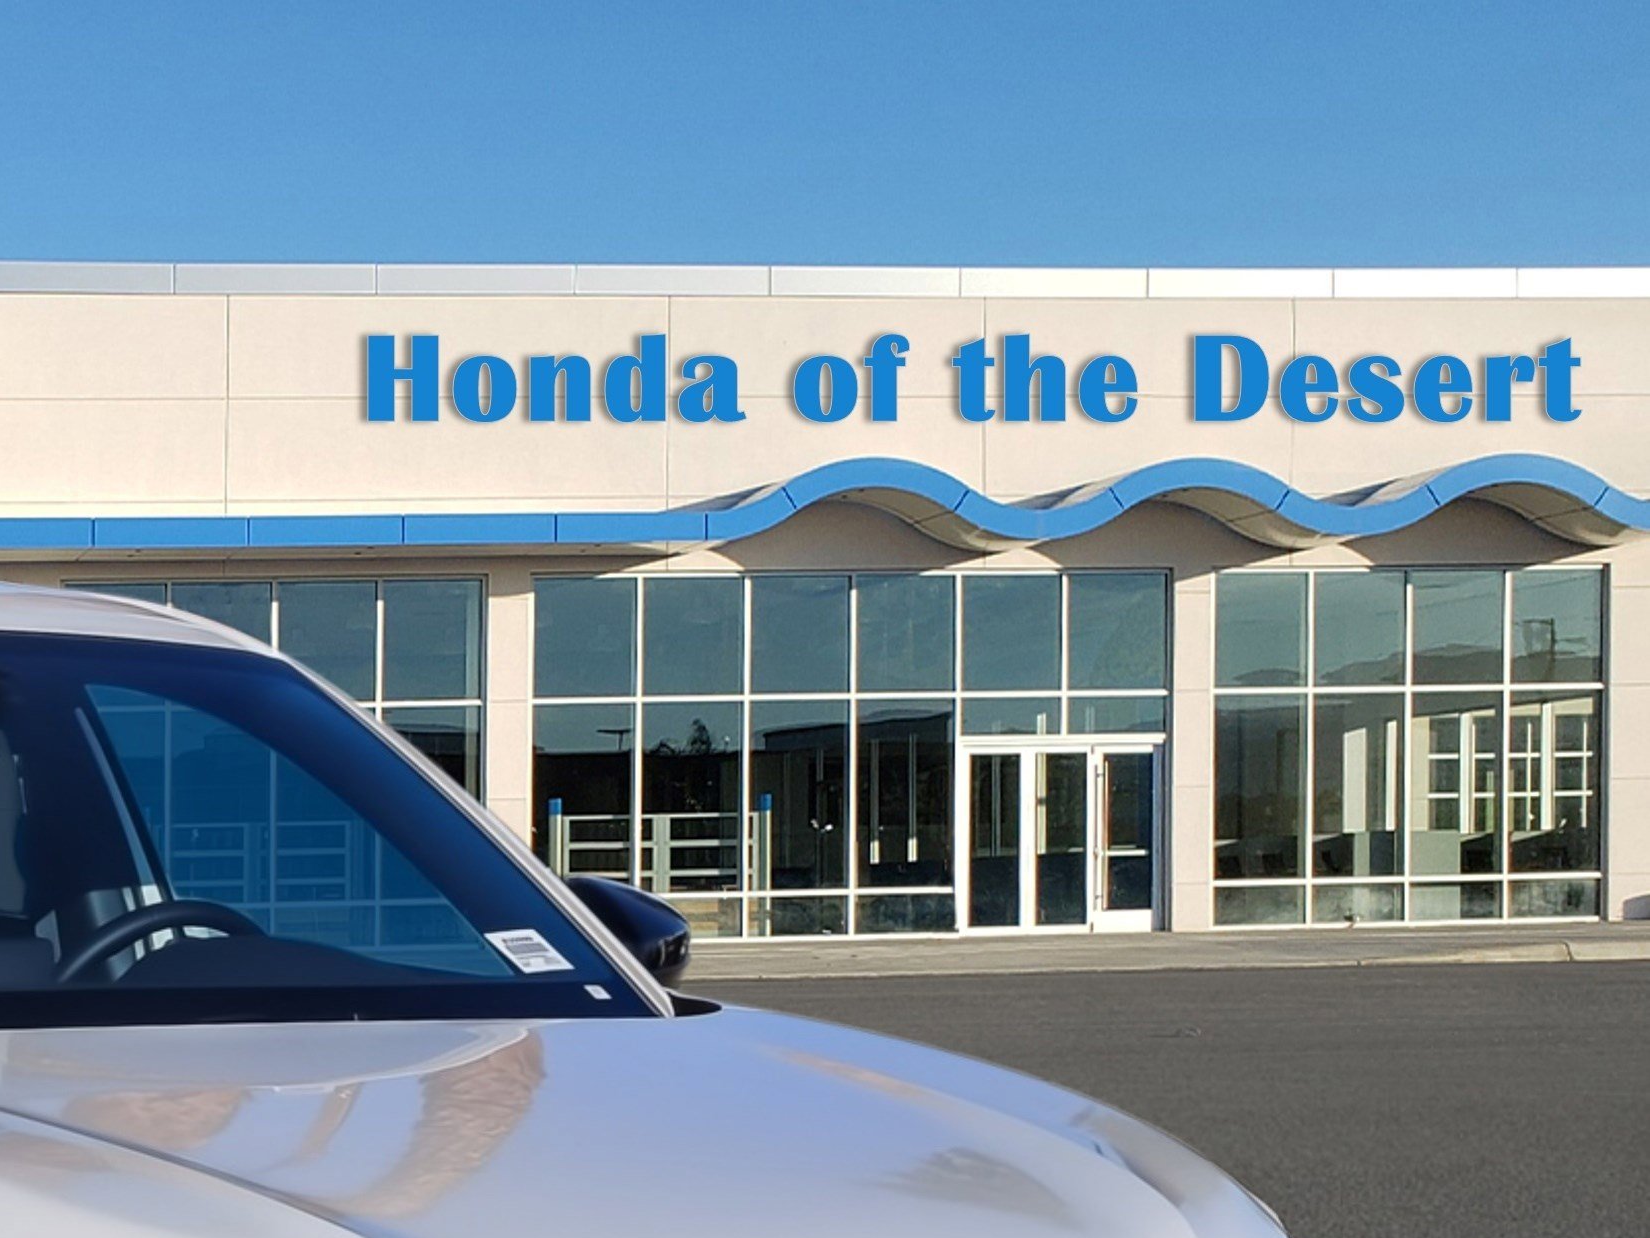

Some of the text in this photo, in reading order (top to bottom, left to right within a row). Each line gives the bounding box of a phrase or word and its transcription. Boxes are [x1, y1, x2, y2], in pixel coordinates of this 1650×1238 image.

[365, 332, 1584, 424] Honda of the Desert
